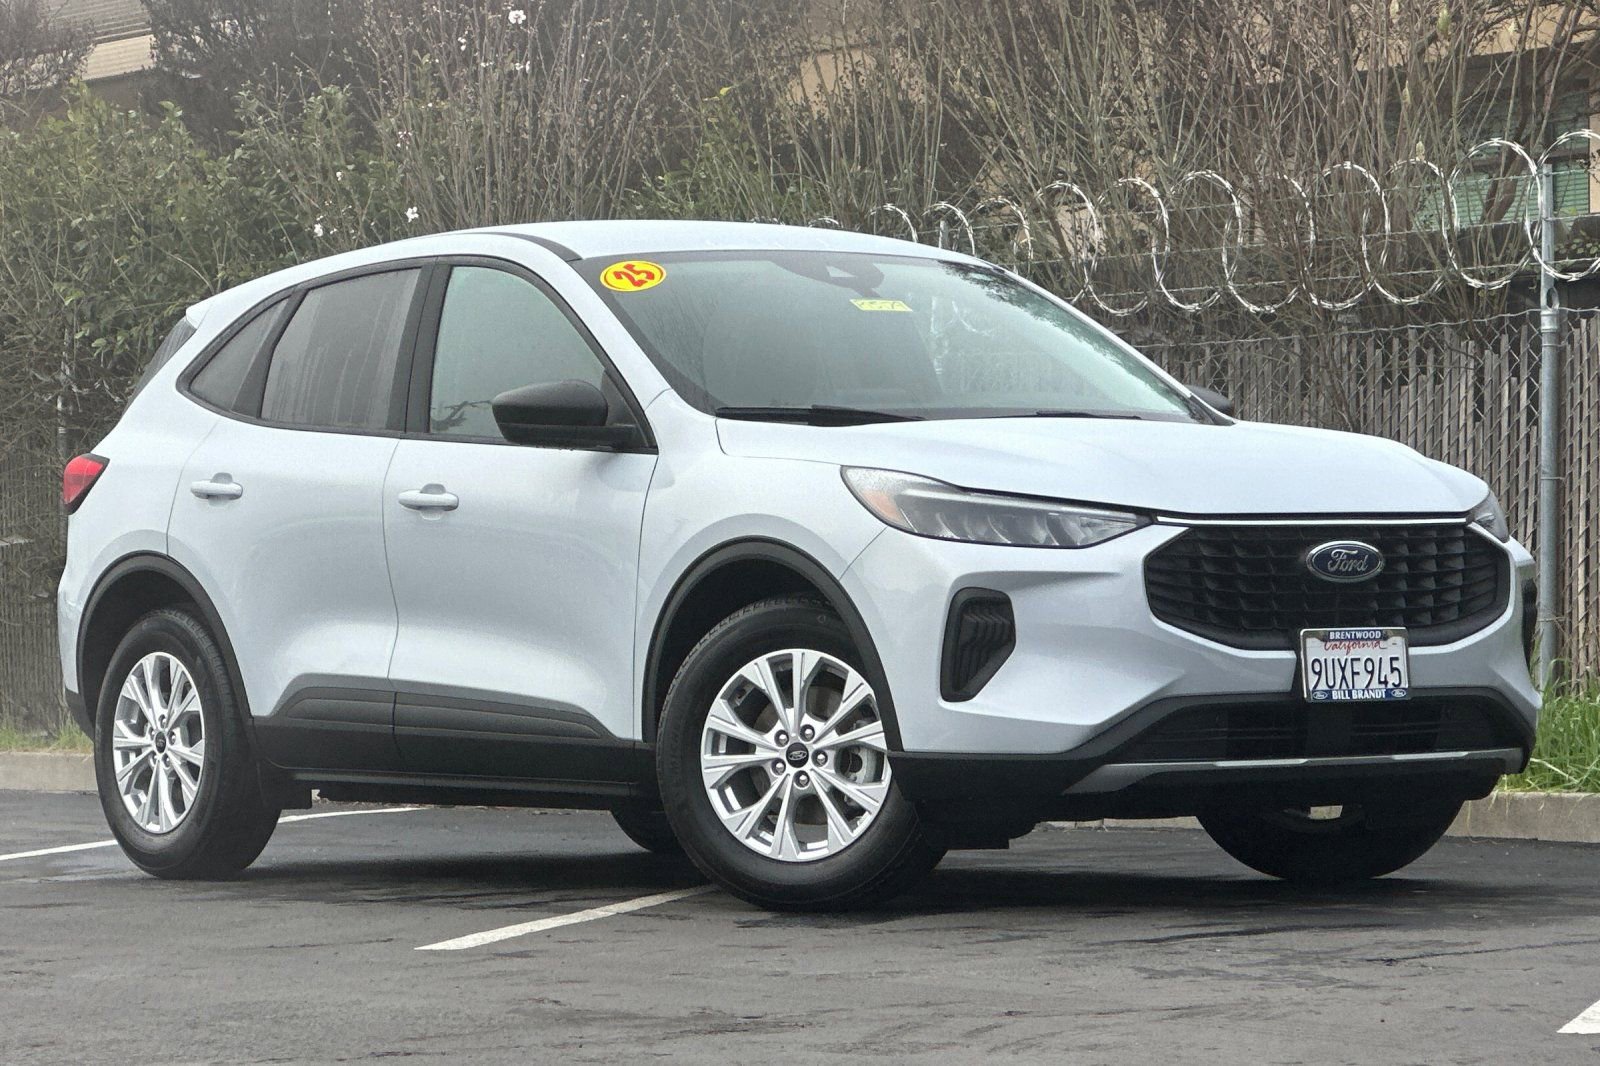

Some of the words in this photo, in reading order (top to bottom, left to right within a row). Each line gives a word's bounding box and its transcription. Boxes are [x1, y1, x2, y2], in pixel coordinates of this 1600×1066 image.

[613, 264, 655, 287] 25
[1327, 549, 1369, 572] Ford
[1329, 630, 1381, 640] BRENTWOOD
[1311, 656, 1403, 690] 9UXF945
[1331, 690, 1350, 700] BILL
[1352, 688, 1387, 699] BRANDT
